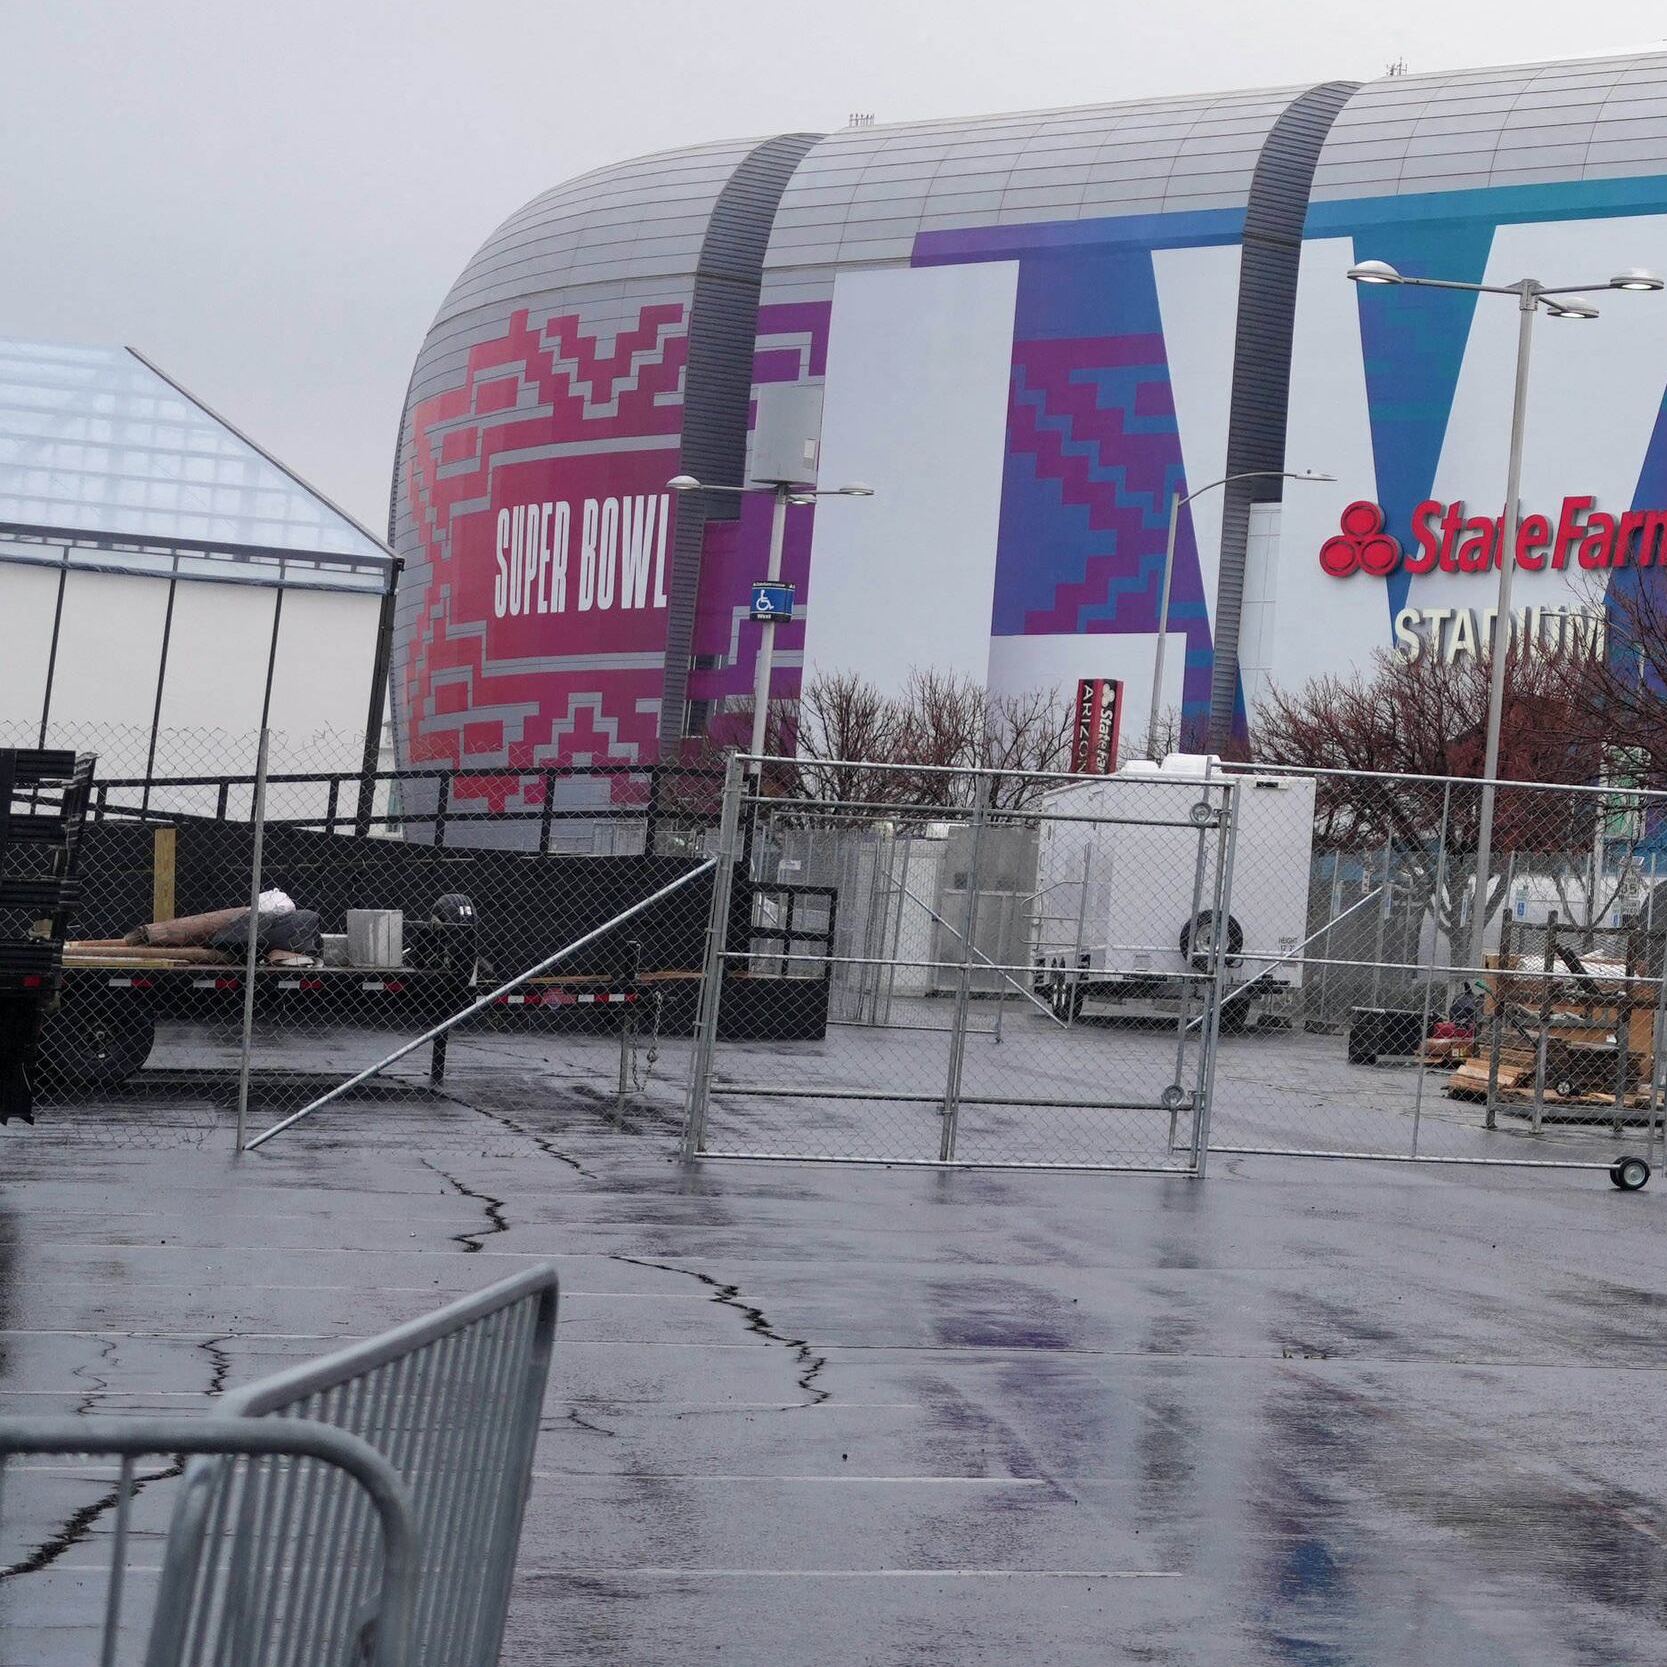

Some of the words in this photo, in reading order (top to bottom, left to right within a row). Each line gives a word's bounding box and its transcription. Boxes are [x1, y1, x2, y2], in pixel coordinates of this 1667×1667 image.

[494, 500, 571, 618] SUPER
[578, 493, 670, 612] BOWL
[1077, 684, 1094, 773] ARIZON
